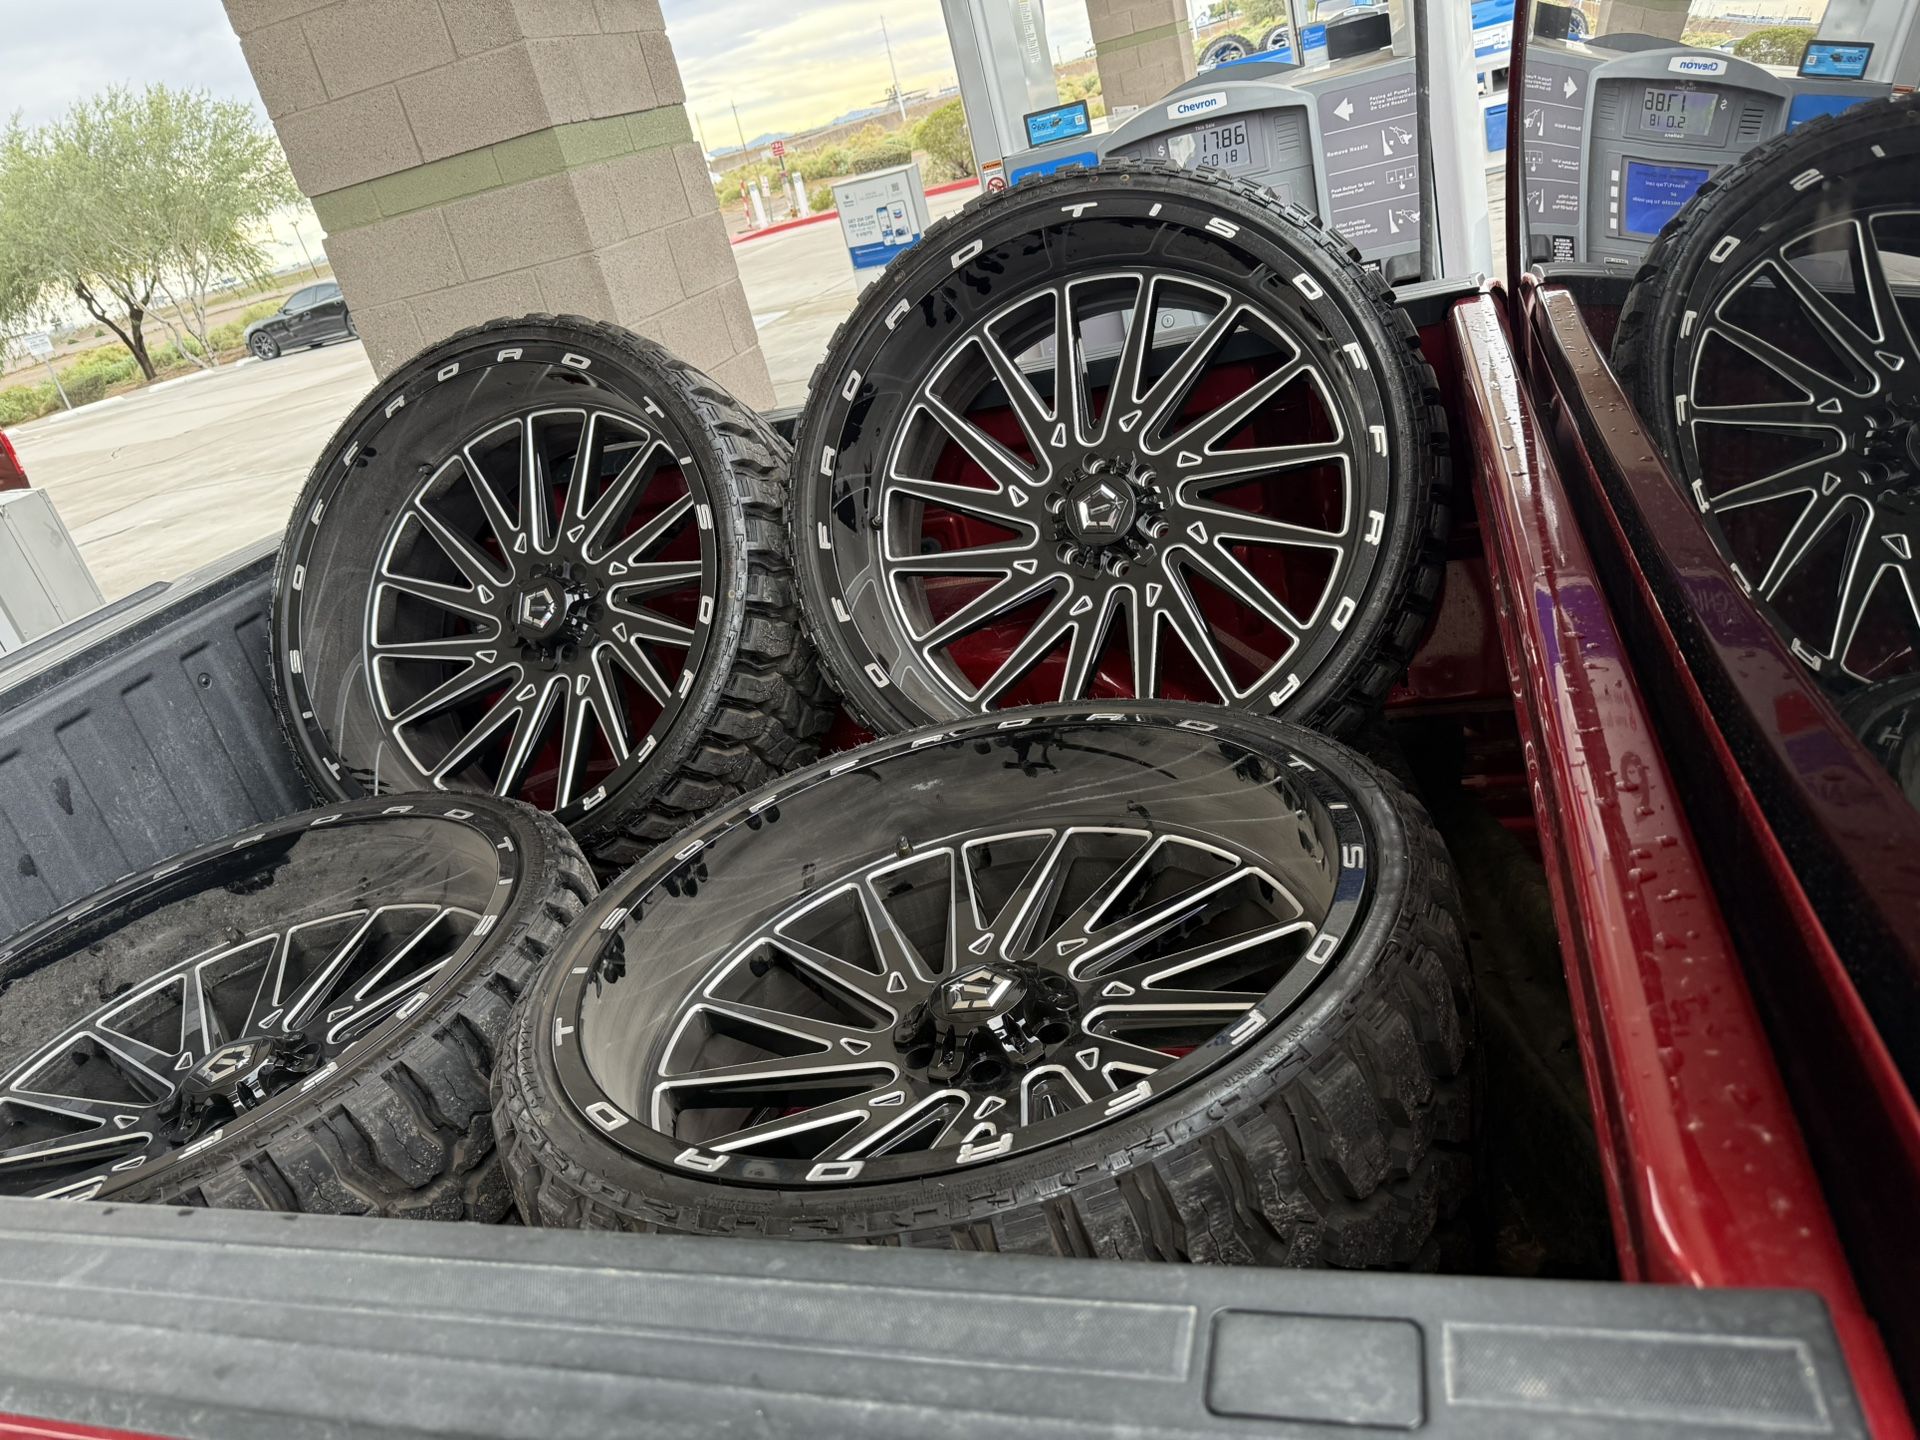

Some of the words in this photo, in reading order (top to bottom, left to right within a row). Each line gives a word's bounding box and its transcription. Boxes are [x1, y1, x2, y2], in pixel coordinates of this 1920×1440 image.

[1177, 97, 1217, 114] Chevron
[1158, 145, 1166, 157] $
[1203, 125, 1245, 152] 17.86
[1326, 149, 1349, 157] Remove
[1349, 144, 1368, 152] Nozzle
[1061, 201, 1240, 239] TIS
